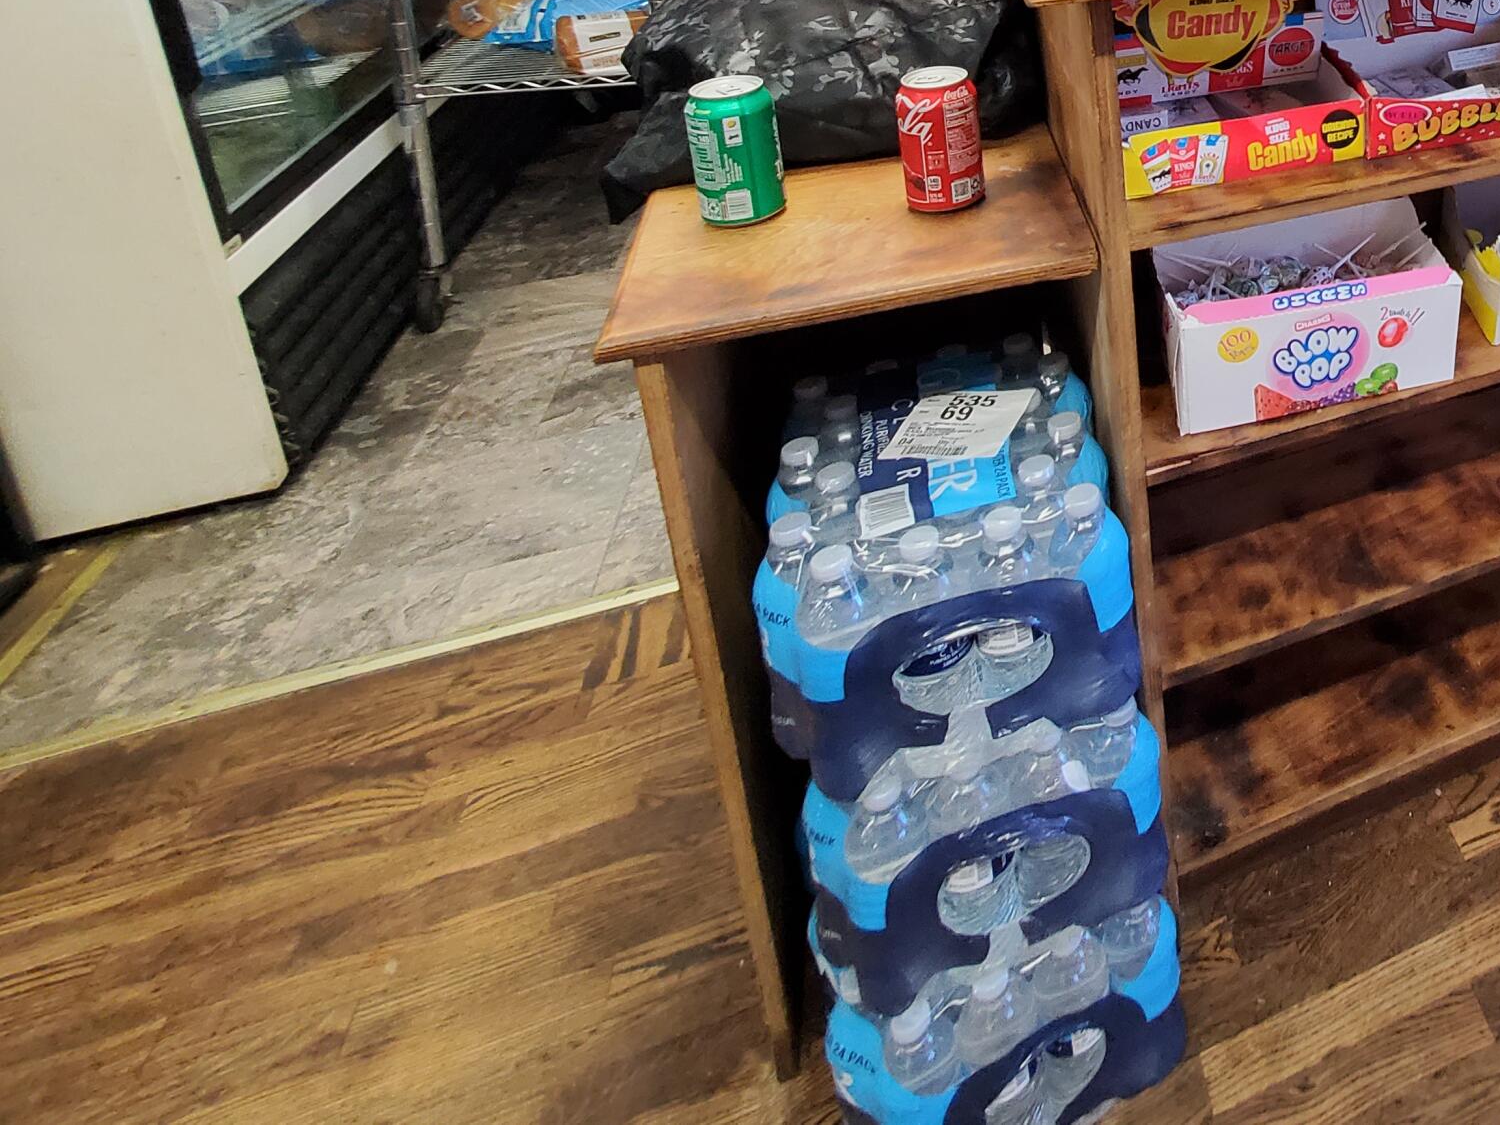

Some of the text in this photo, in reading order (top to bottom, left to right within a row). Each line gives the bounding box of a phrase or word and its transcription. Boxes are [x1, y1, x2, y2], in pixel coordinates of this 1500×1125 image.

[1166, 3, 1259, 42] Candy
[1247, 127, 1319, 172] Candy
[1272, 280, 1367, 312] CHARMS
[1380, 306, 1390, 321] 2
[1218, 327, 1252, 353] 100
[1273, 325, 1359, 374] BLOW
[1292, 349, 1352, 390] POP
[940, 405, 974, 421] 69
[950, 394, 998, 407] 535
[858, 452, 874, 479] WATER
[763, 608, 792, 628] PACK
